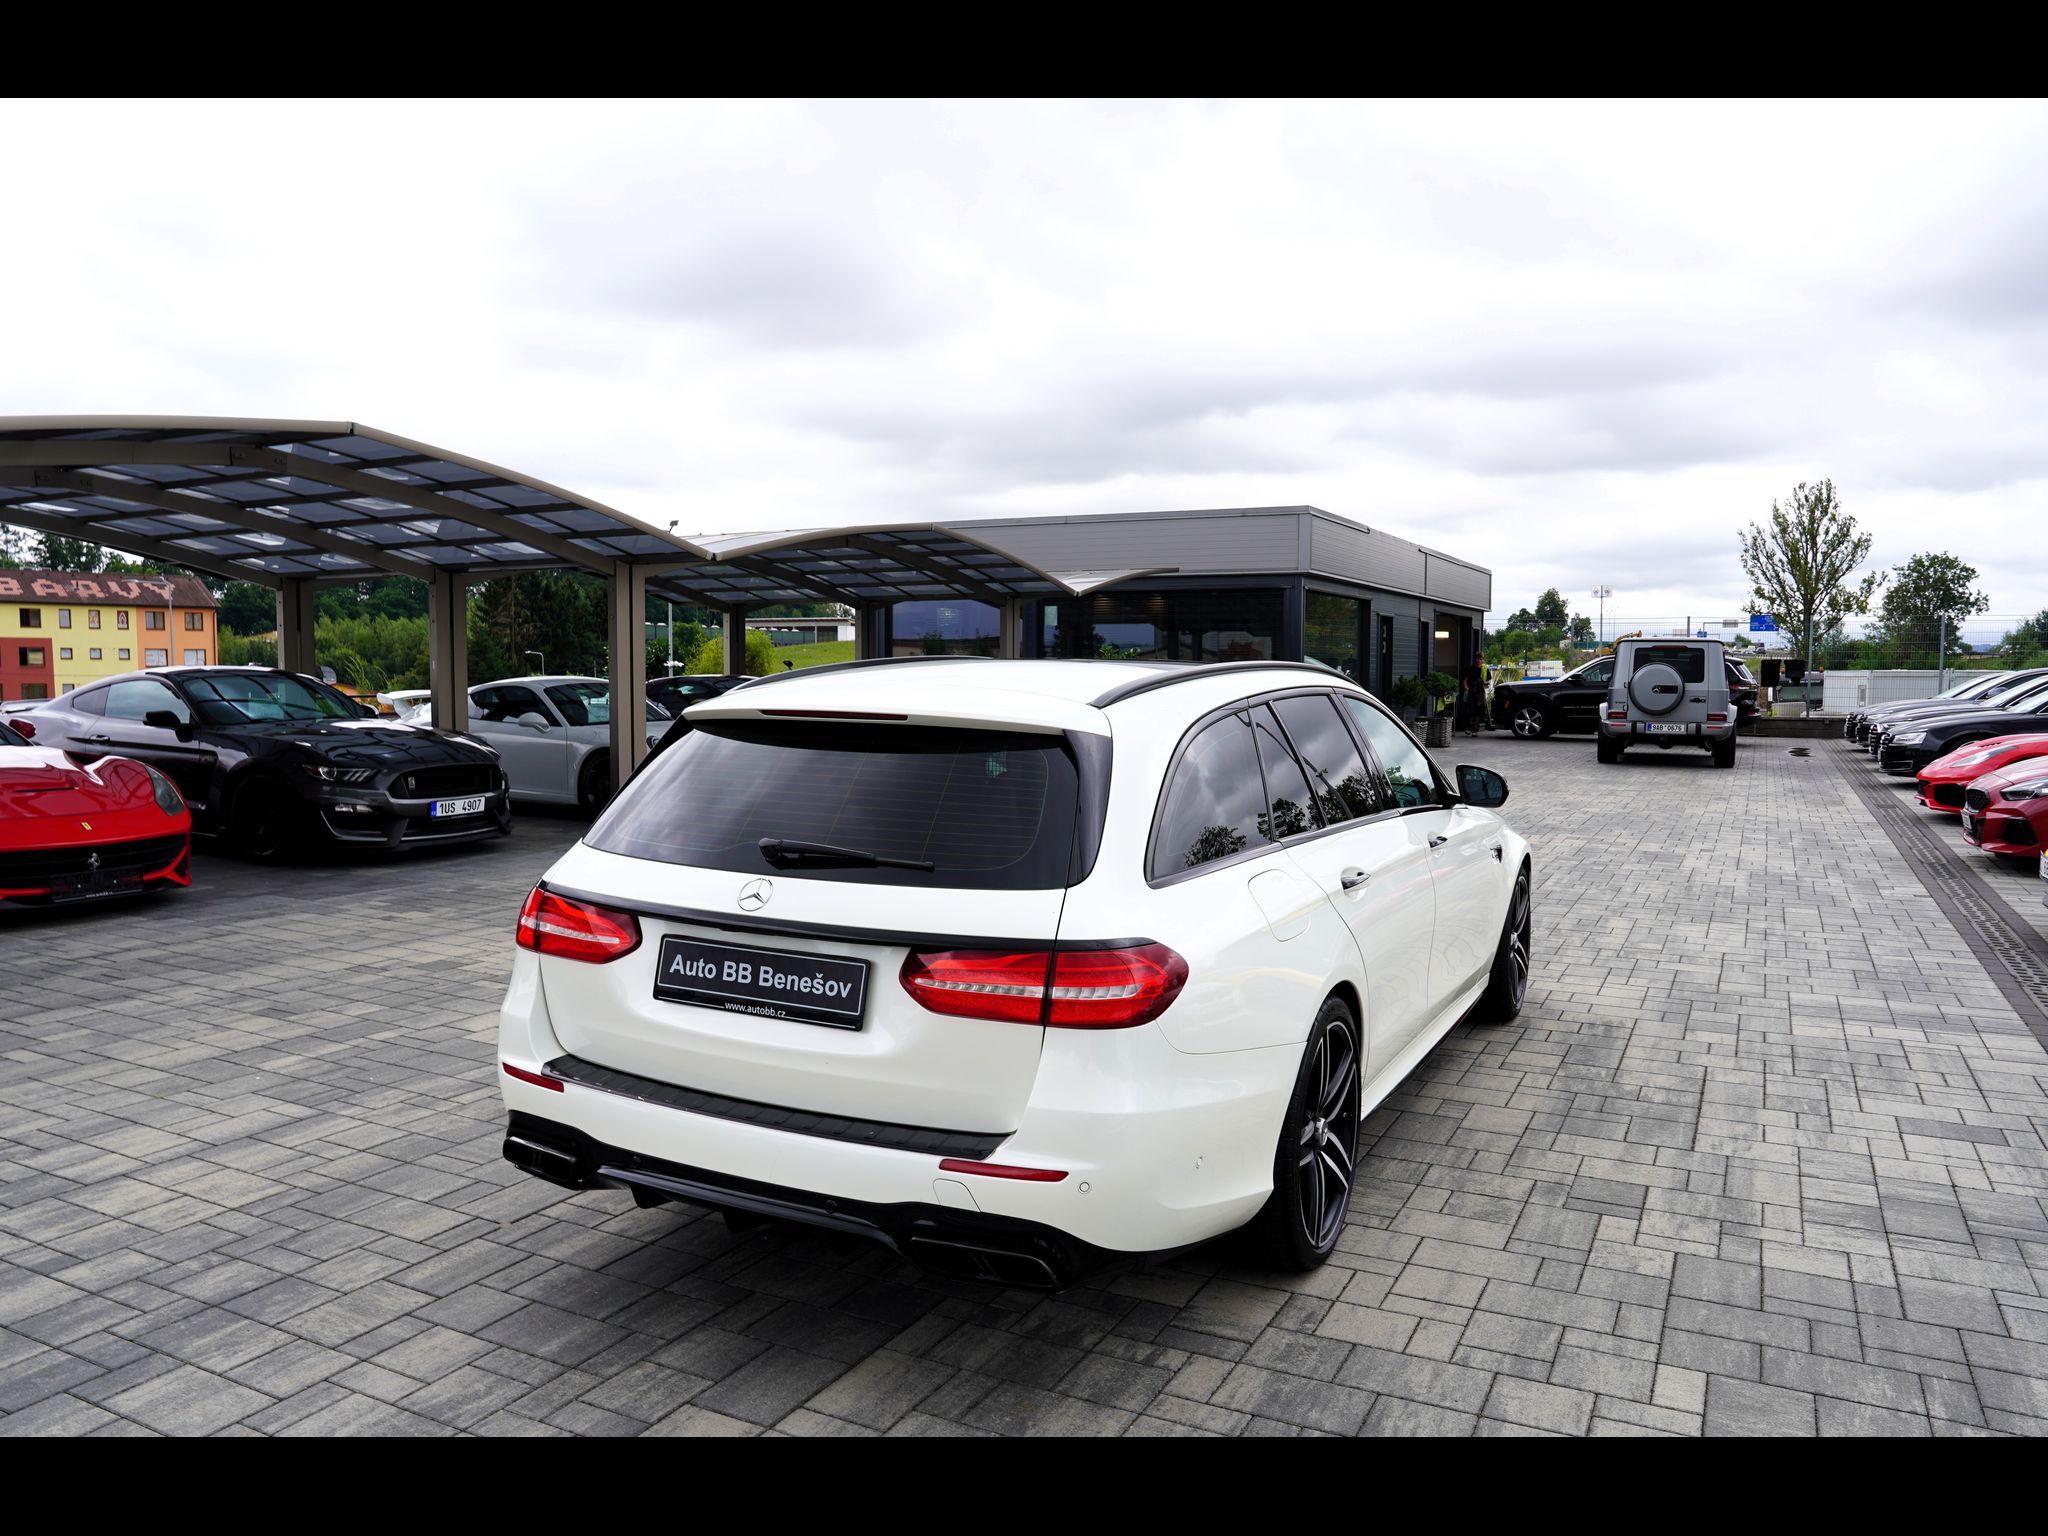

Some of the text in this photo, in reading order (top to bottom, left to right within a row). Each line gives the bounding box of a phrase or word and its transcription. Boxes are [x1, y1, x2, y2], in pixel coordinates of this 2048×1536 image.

[440, 799, 481, 814] 1US 4907
[669, 954, 852, 998] Auto BB Benešov
[724, 1002, 786, 1018] www.autobb.cz
